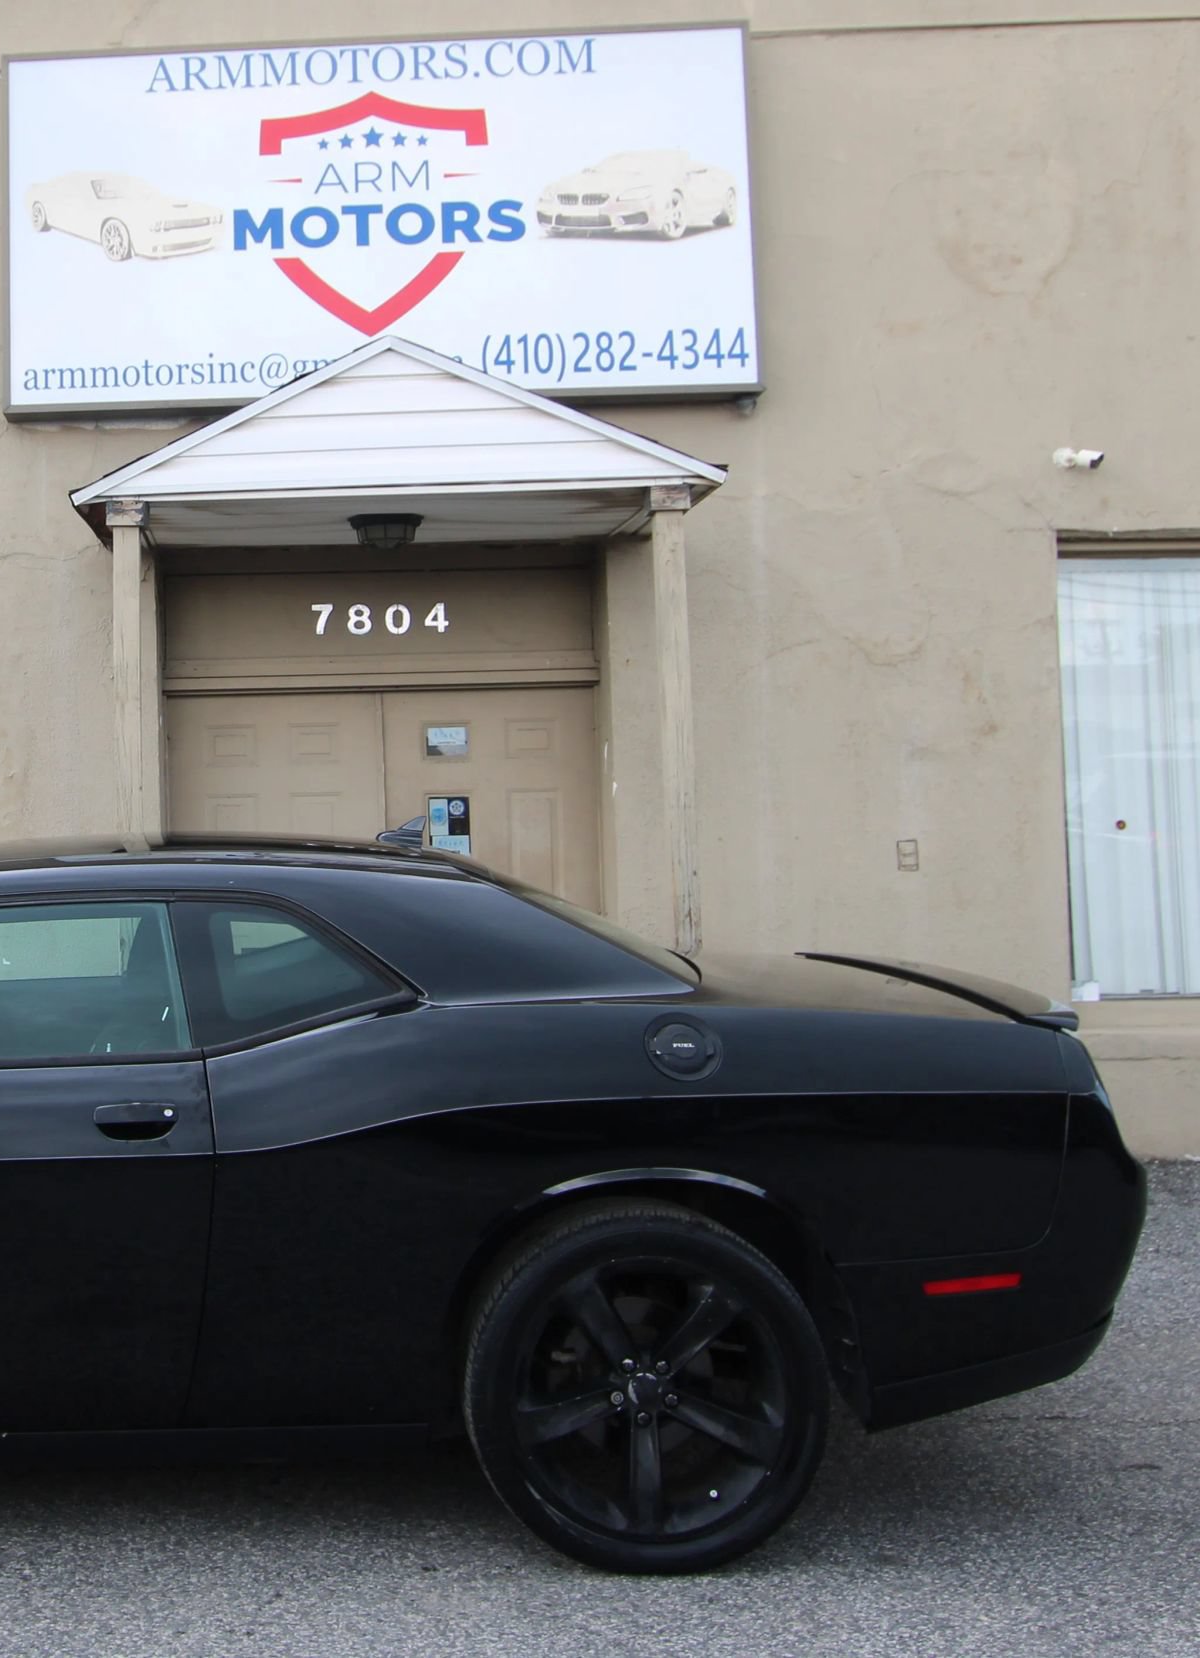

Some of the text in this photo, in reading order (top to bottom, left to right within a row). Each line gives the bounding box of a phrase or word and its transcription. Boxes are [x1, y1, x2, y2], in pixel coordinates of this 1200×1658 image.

[145, 38, 597, 93] ARMMOTORS.COM
[314, 159, 430, 194] ARM
[233, 199, 527, 251] MOTORS
[481, 327, 750, 382] (410)282-4344
[311, 602, 450, 635] 7804
